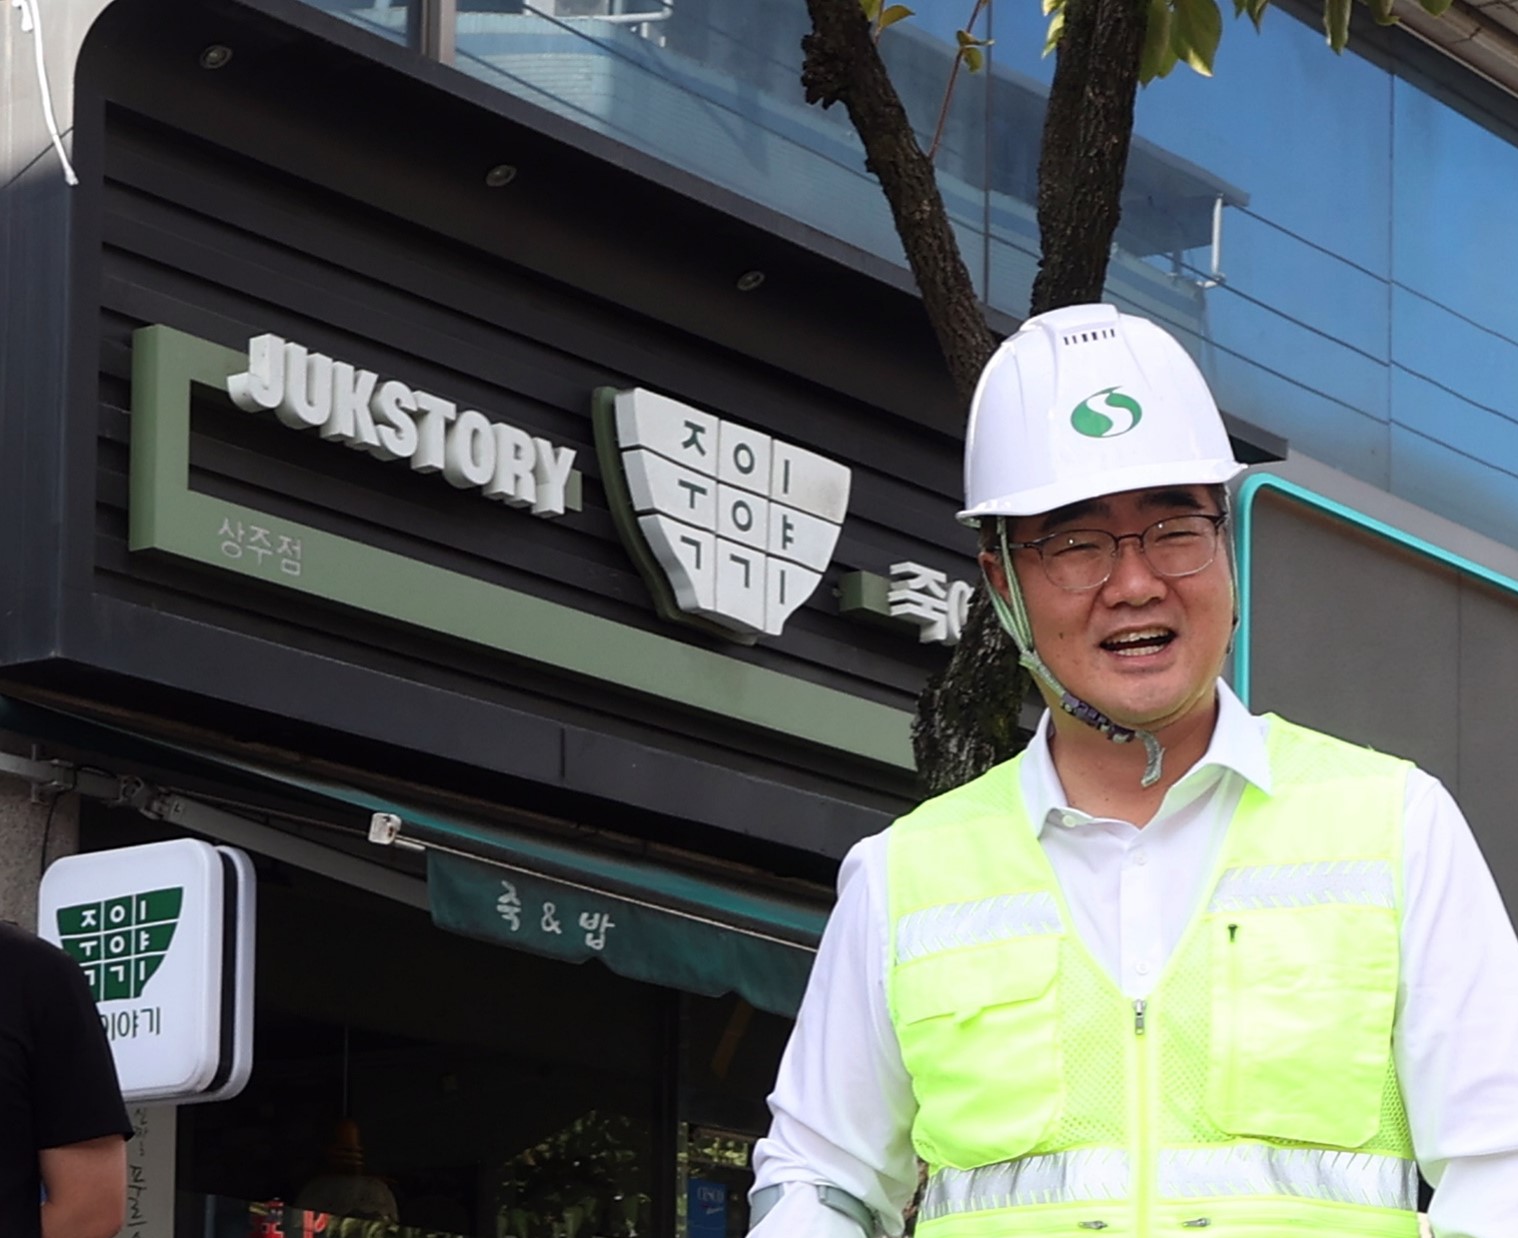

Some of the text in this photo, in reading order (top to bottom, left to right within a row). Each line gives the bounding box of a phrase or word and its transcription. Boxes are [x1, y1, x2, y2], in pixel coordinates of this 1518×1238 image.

[227, 333, 577, 519] JUKSTORY
[218, 517, 302, 576] 상주점
[497, 880, 616, 950] 죽 & 밥
